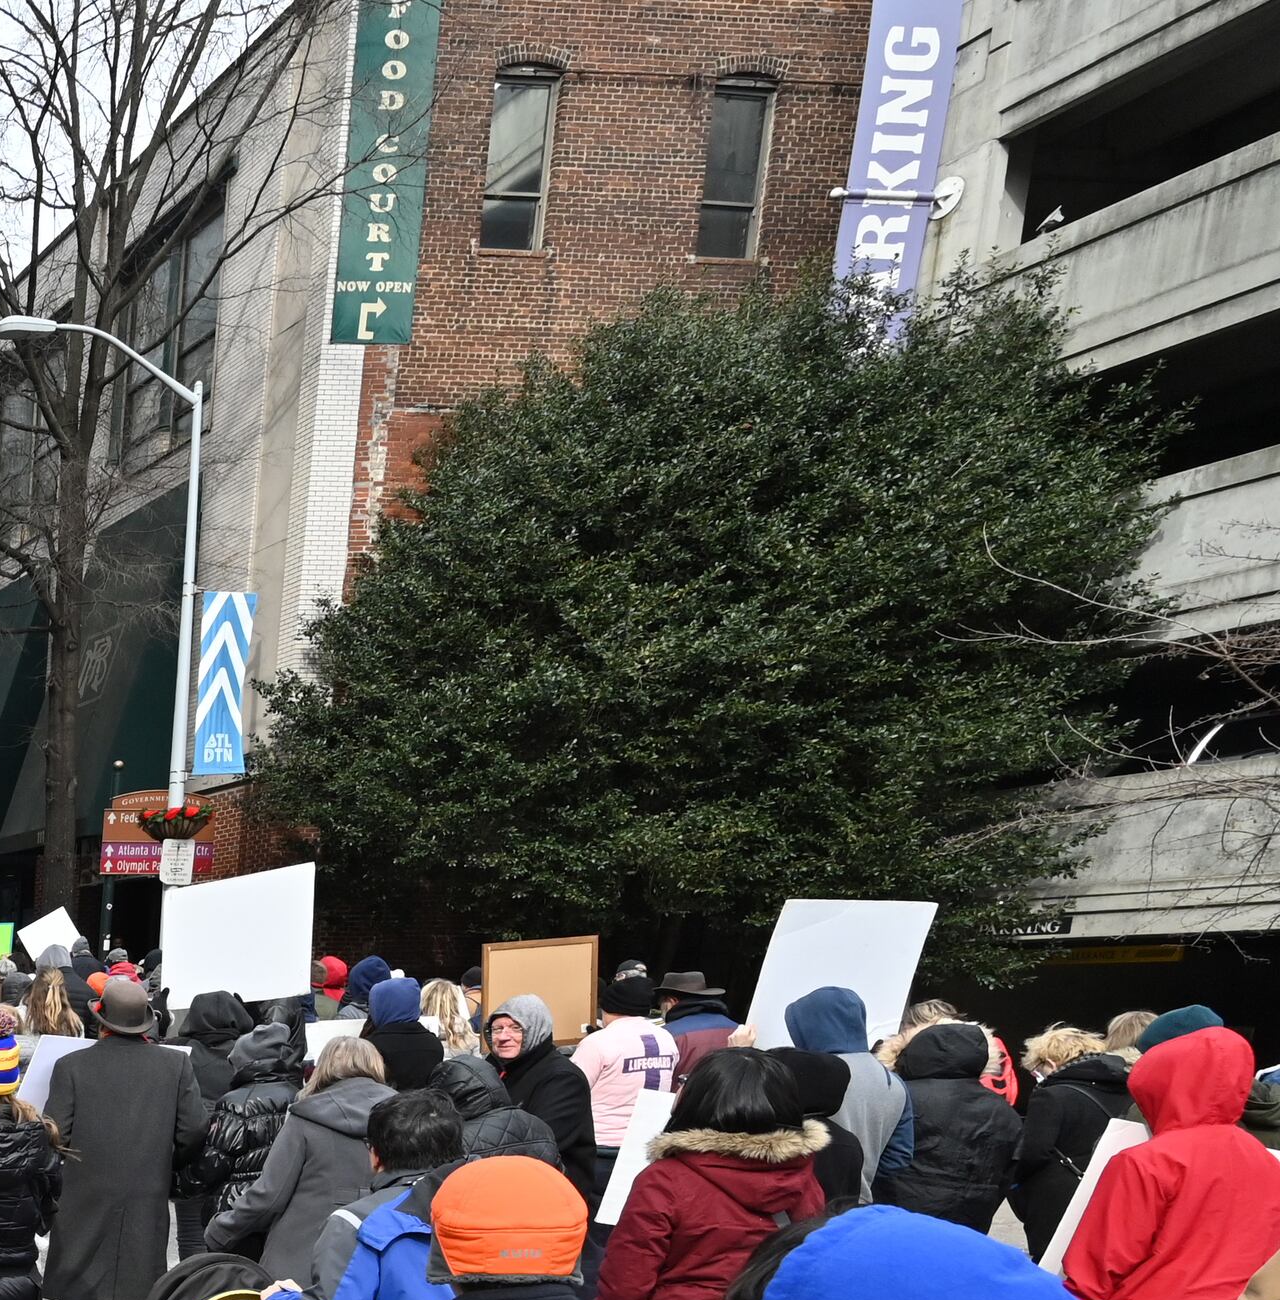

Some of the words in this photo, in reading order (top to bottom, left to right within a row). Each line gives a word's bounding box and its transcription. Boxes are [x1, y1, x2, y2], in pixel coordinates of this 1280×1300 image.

[378, 1, 412, 110] FOOD
[843, 26, 940, 345] ARKING
[366, 134, 400, 271] COURT
[337, 281, 371, 293] NOW
[376, 281, 412, 293] OPEN
[205, 733, 232, 748] ATL
[204, 748, 232, 763] DTN
[121, 795, 169, 806] GOVERNME
[120, 813, 139, 823] Fede
[118, 844, 148, 856] Atlanta
[196, 845, 209, 856] Ctr.
[117, 860, 149, 873] Olympic
[152, 861, 161, 871] Pa
[628, 1056, 671, 1071] LIFEGUARD
